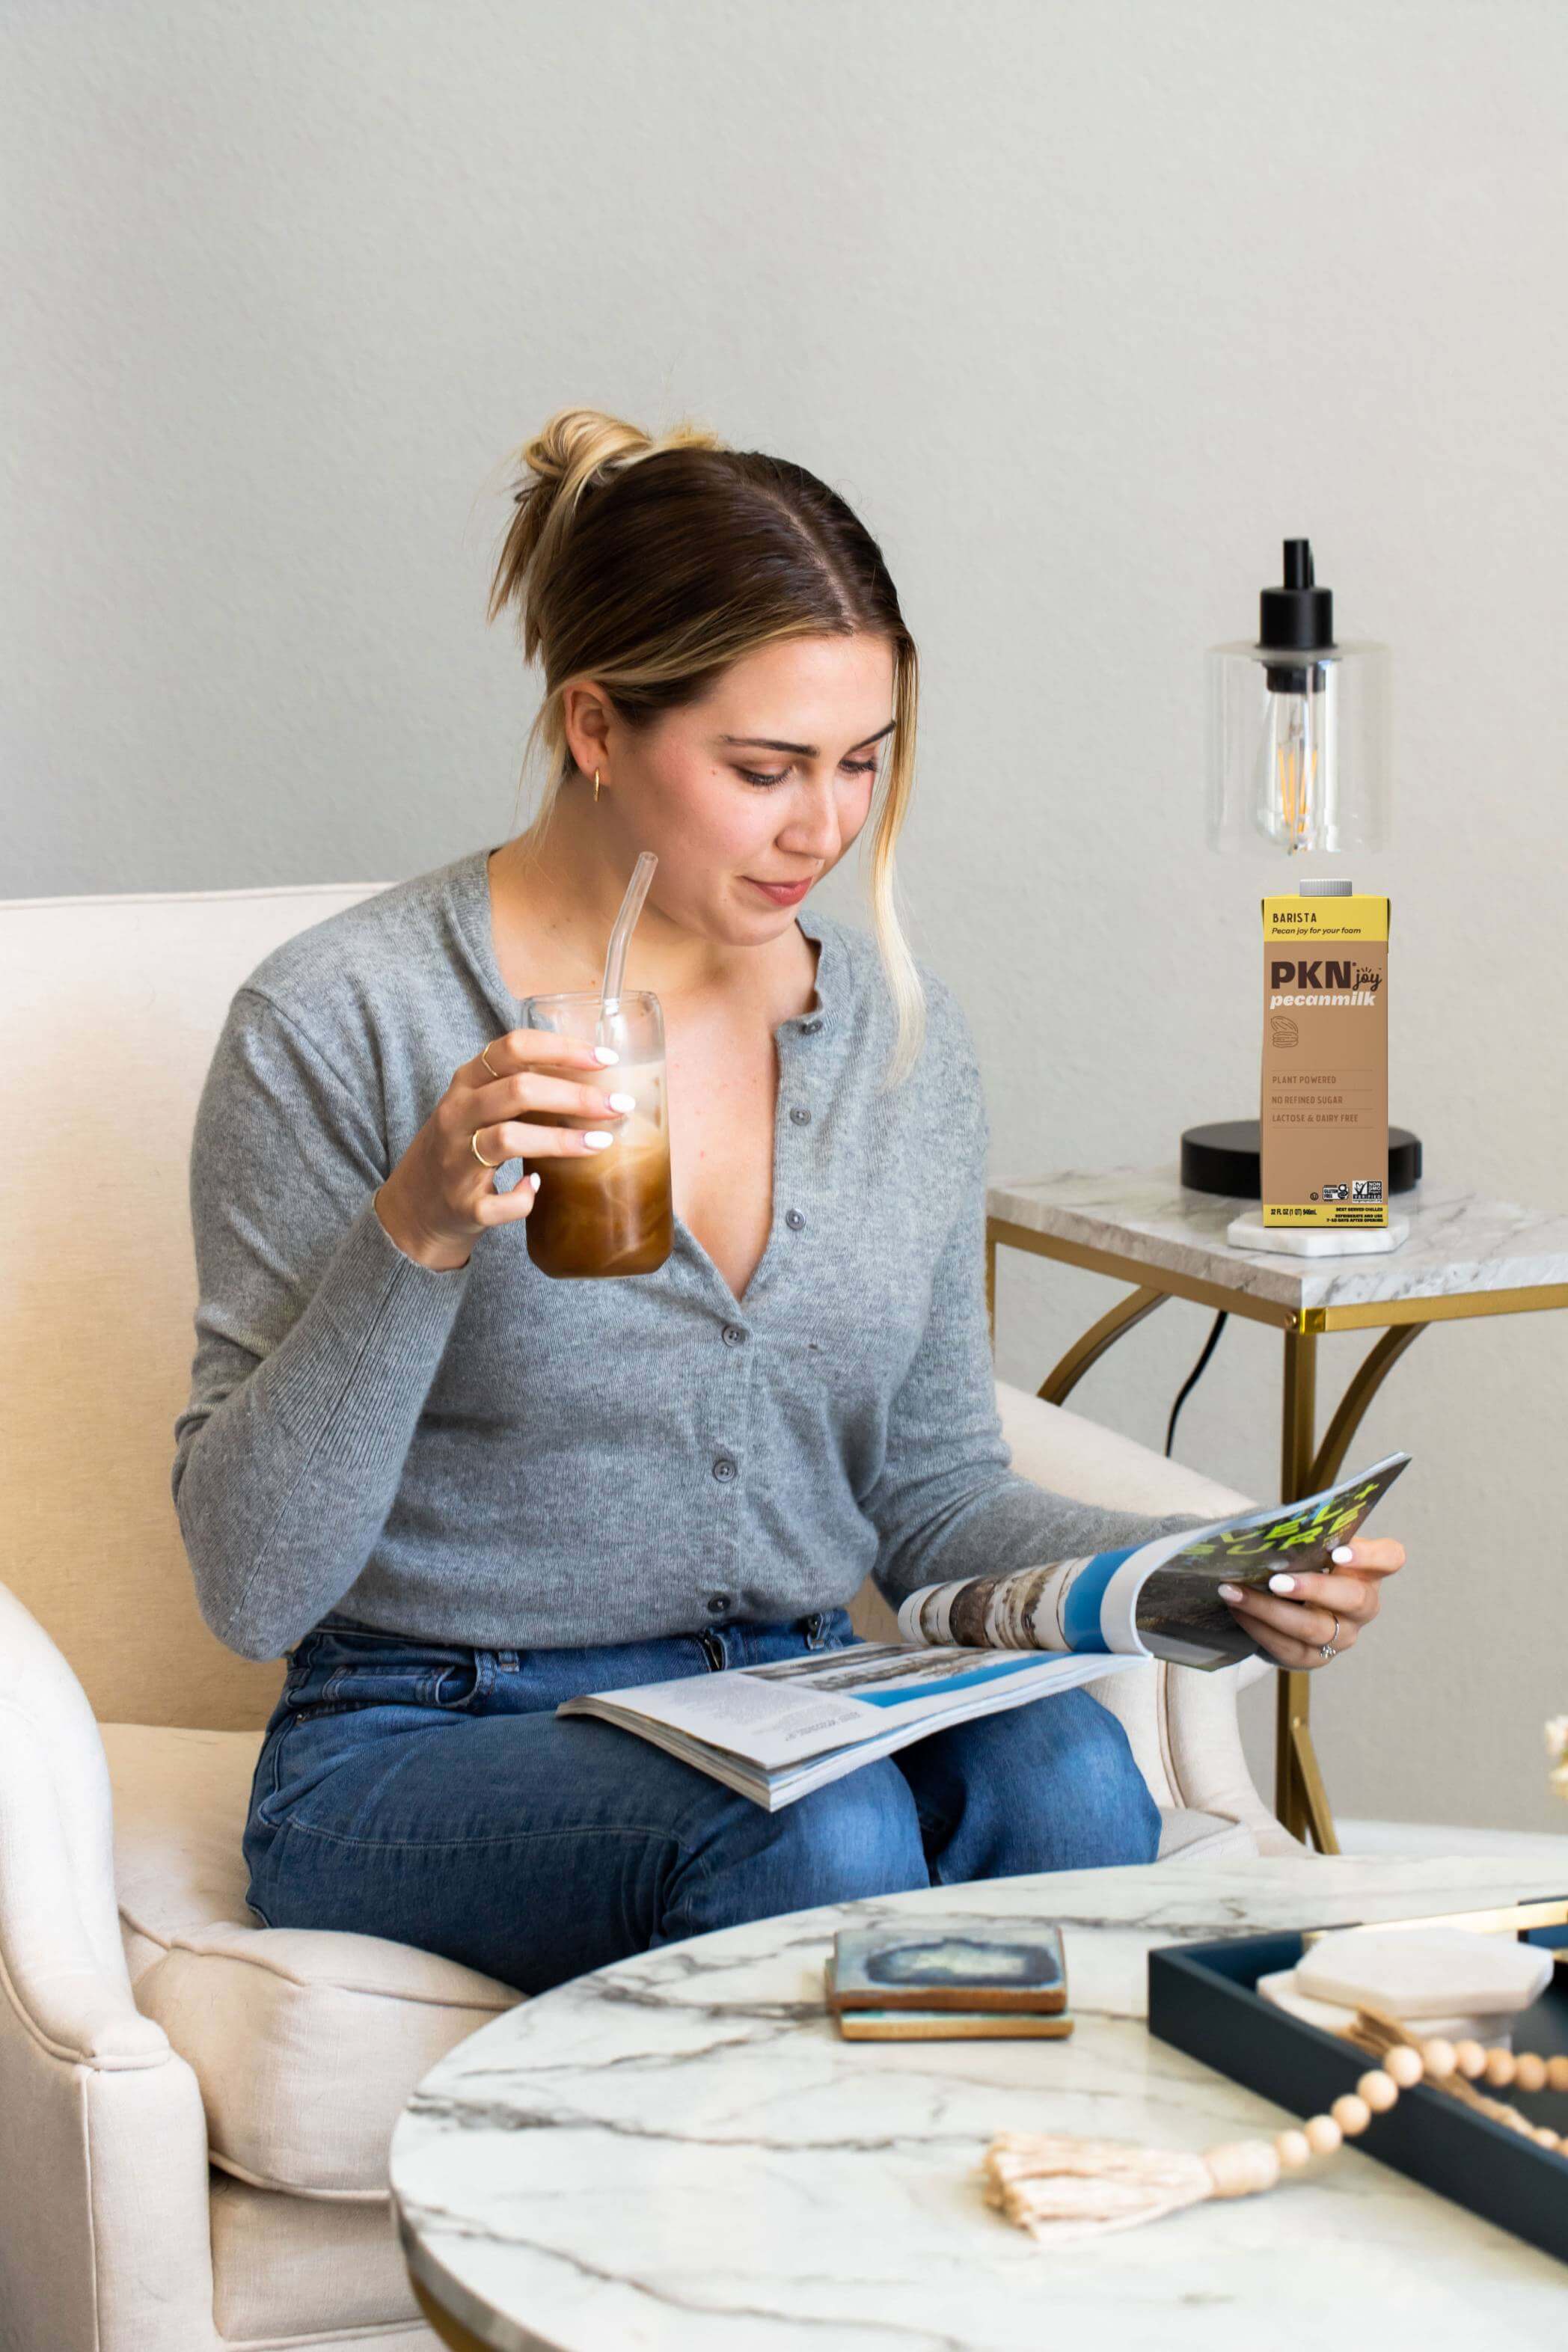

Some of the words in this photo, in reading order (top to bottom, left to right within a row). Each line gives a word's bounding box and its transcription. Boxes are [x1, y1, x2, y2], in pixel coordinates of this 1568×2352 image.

[1273, 913, 1317, 922] BARISTA
[1271, 961, 1351, 989] PKN
[1353, 969, 1382, 991] joy
[1270, 991, 1376, 1009] pecanmilk
[1273, 1076, 1296, 1084] PLANT
[1299, 1076, 1337, 1084] POWERED
[1272, 1096, 1282, 1104] NO
[1284, 1096, 1315, 1104] REFINED
[1317, 1096, 1343, 1104] SUGAR
[1272, 1114, 1305, 1122] LACTOSE
[1307, 1114, 1314, 1122] &
[1316, 1114, 1339, 1122] DAIRY
[1341, 1114, 1359, 1122] FREE
